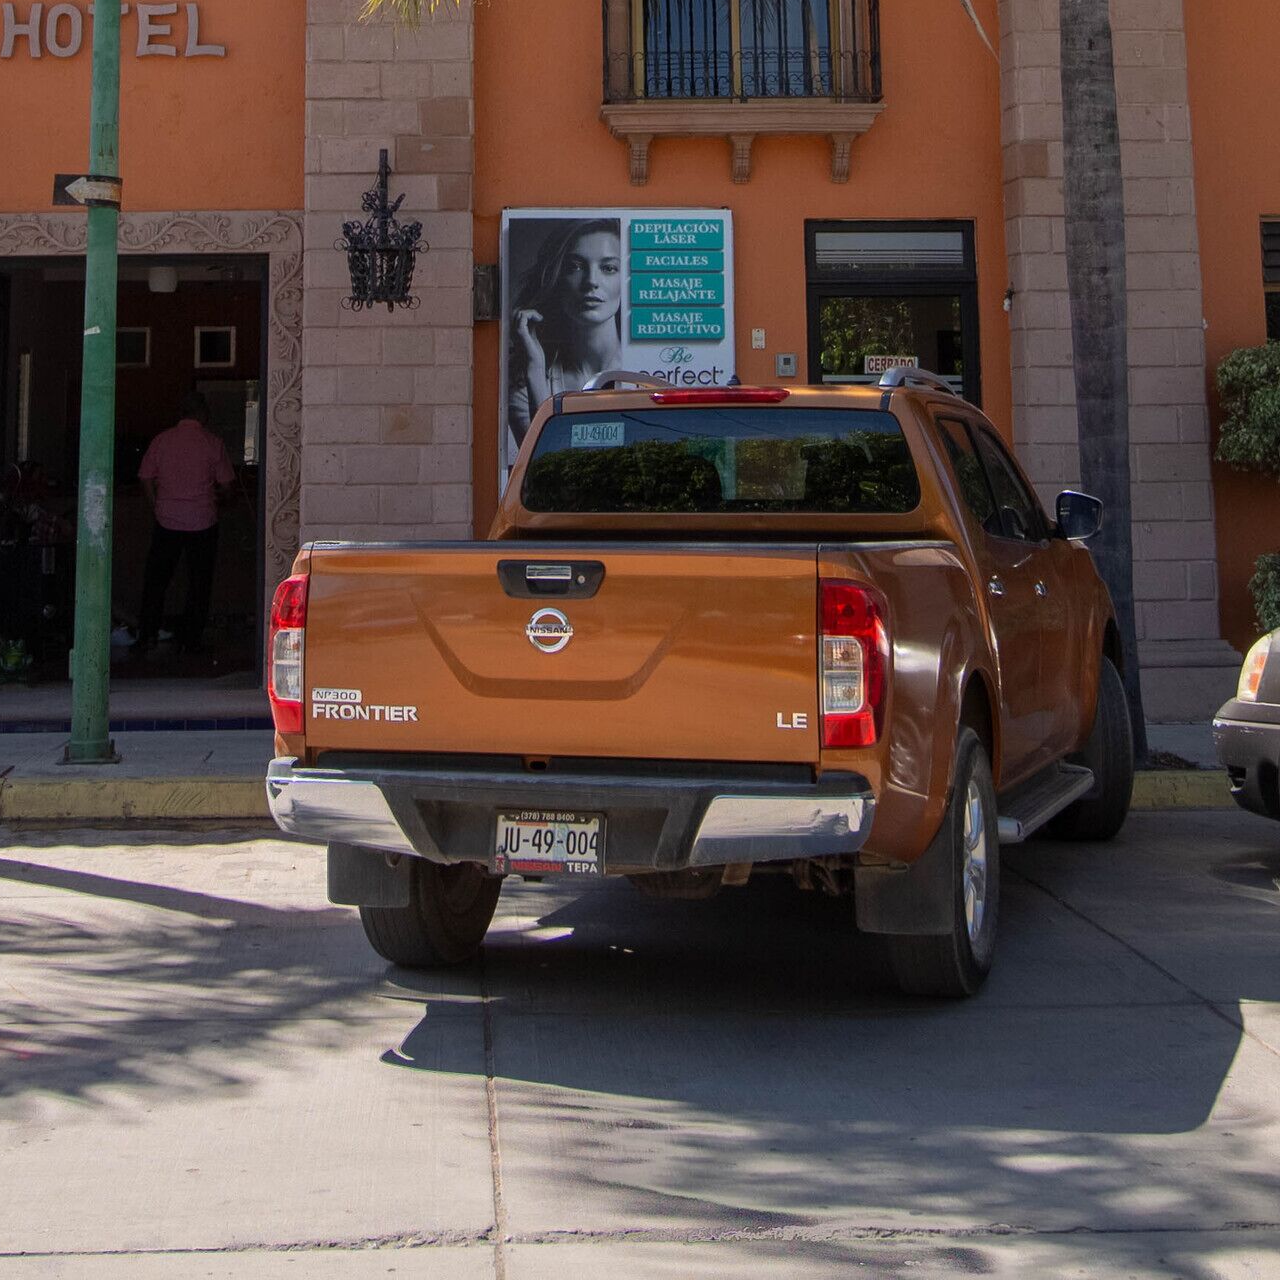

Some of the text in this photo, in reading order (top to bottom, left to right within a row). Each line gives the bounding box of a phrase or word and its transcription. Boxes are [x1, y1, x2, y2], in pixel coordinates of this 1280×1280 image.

[0, 2, 227, 59] HOEL
[634, 222, 719, 234] DEPILACIÓN
[654, 232, 697, 244] LÁSER
[645, 255, 709, 266] FACIALES
[651, 278, 704, 290] MASAJE
[638, 289, 716, 302] RELAJANTE
[651, 312, 704, 324] MASAJE
[636, 323, 721, 334] REDUCTIVO
[659, 346, 695, 363] Be
[638, 365, 721, 387] erfect
[315, 690, 357, 701] NP300
[312, 703, 419, 722] FRONTIER
[776, 712, 808, 729] LE
[501, 826, 599, 855] JU-49-004
[566, 861, 598, 874] TEPA
